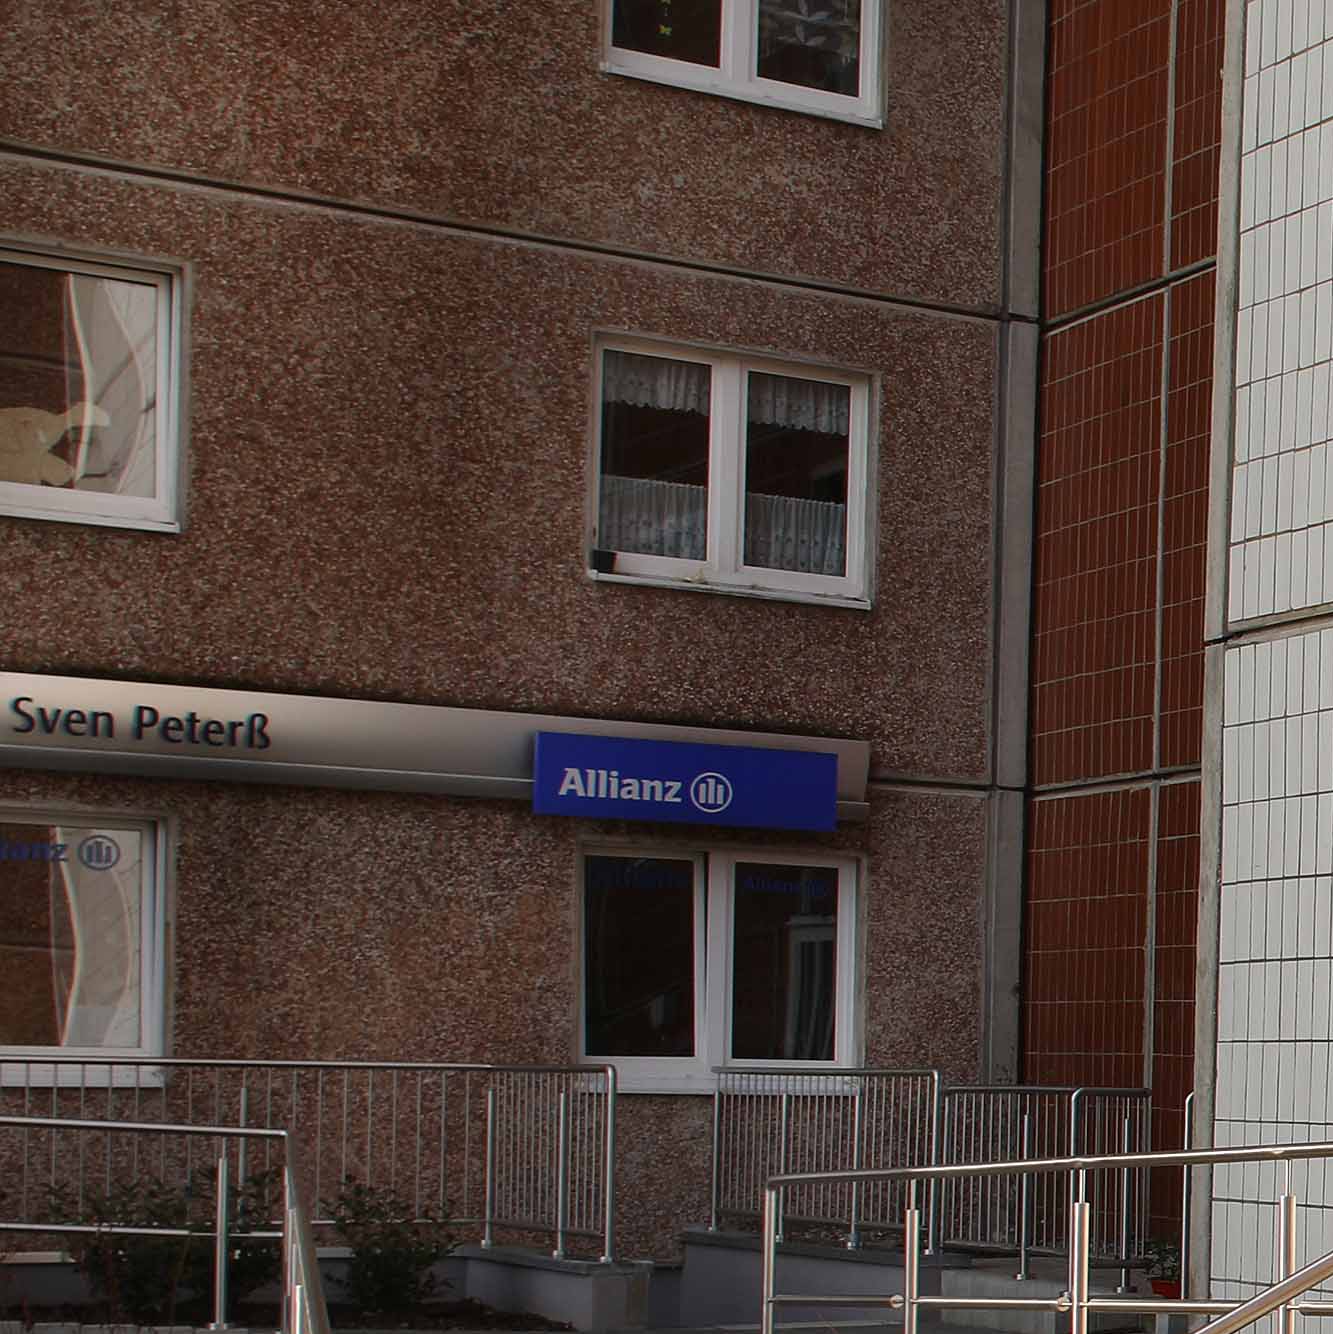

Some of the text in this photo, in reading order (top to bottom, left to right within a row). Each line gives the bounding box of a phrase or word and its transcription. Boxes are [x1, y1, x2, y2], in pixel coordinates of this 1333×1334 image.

[11, 696, 272, 750] Sven Peterß
[558, 767, 682, 803] Allianz
